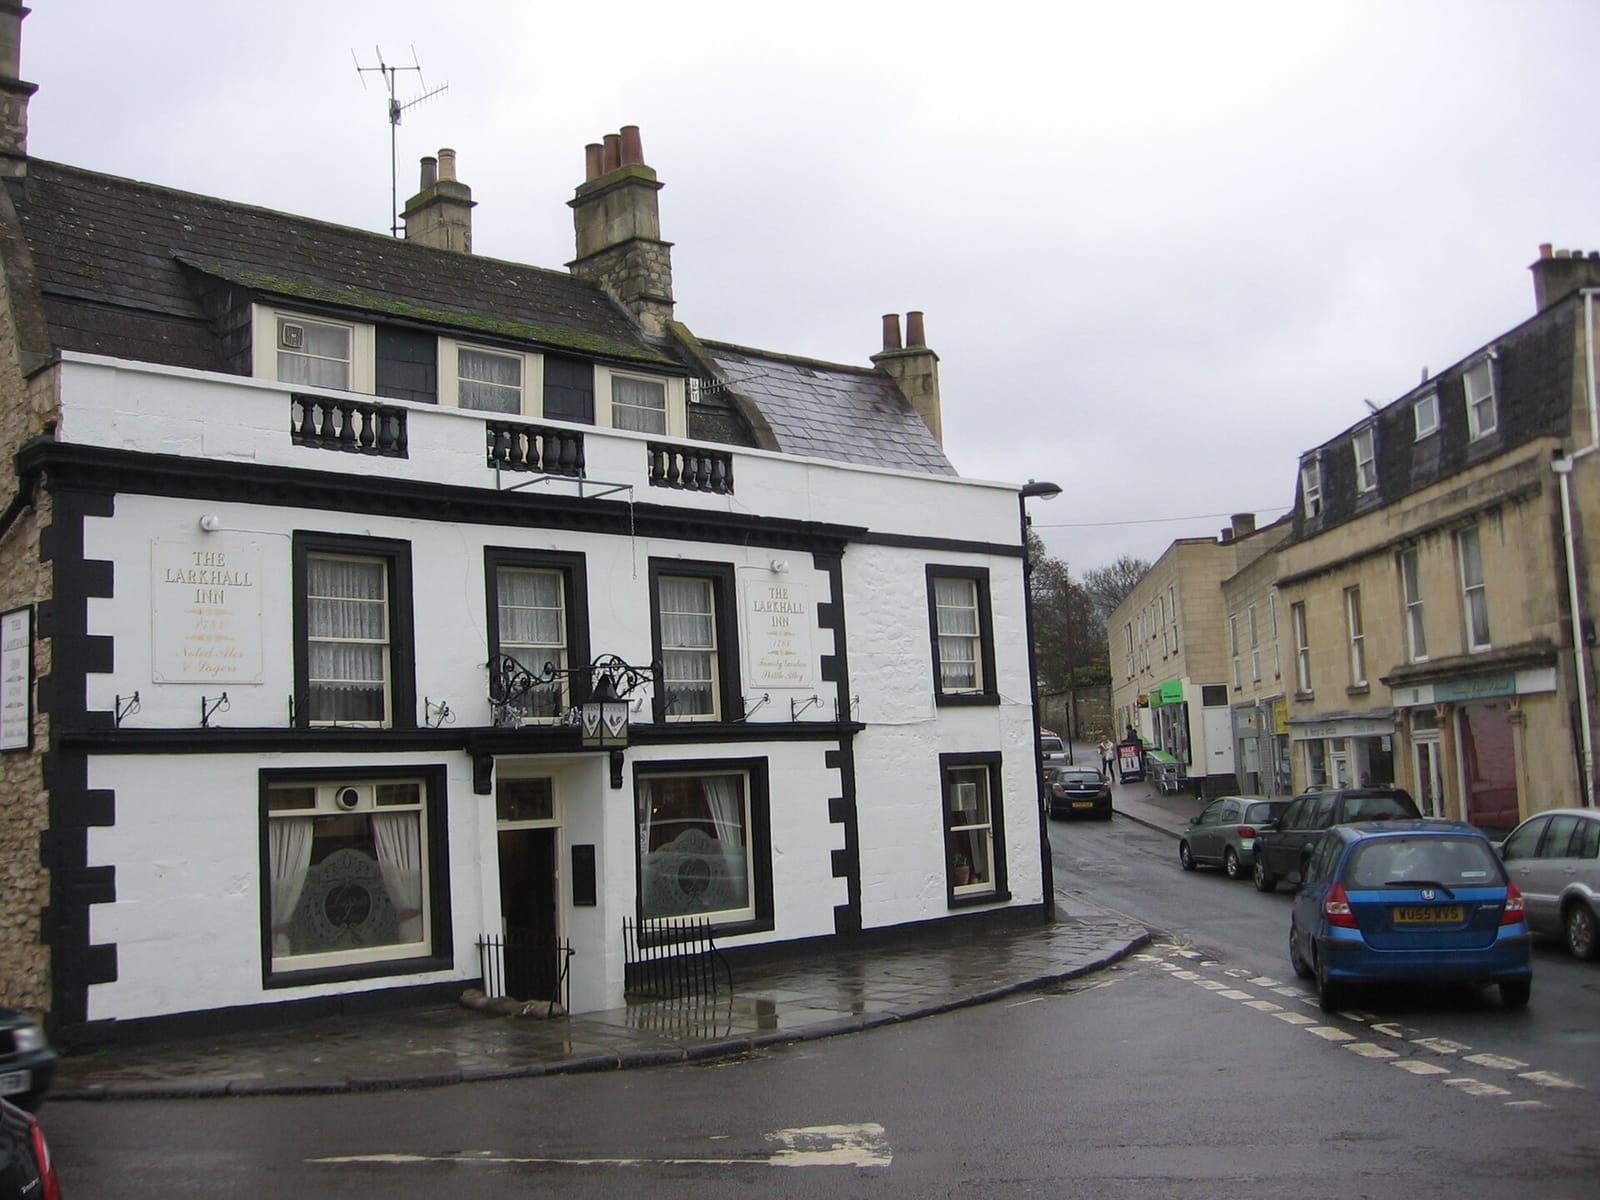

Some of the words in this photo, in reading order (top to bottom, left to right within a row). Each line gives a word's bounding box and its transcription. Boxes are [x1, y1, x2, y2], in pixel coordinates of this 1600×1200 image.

[193, 551, 225, 567] THE
[164, 568, 253, 586] LARKHALL
[194, 588, 225, 604] INN
[768, 588, 788, 599] THE
[754, 601, 805, 614] LARKHALL
[772, 616, 789, 627] INN
